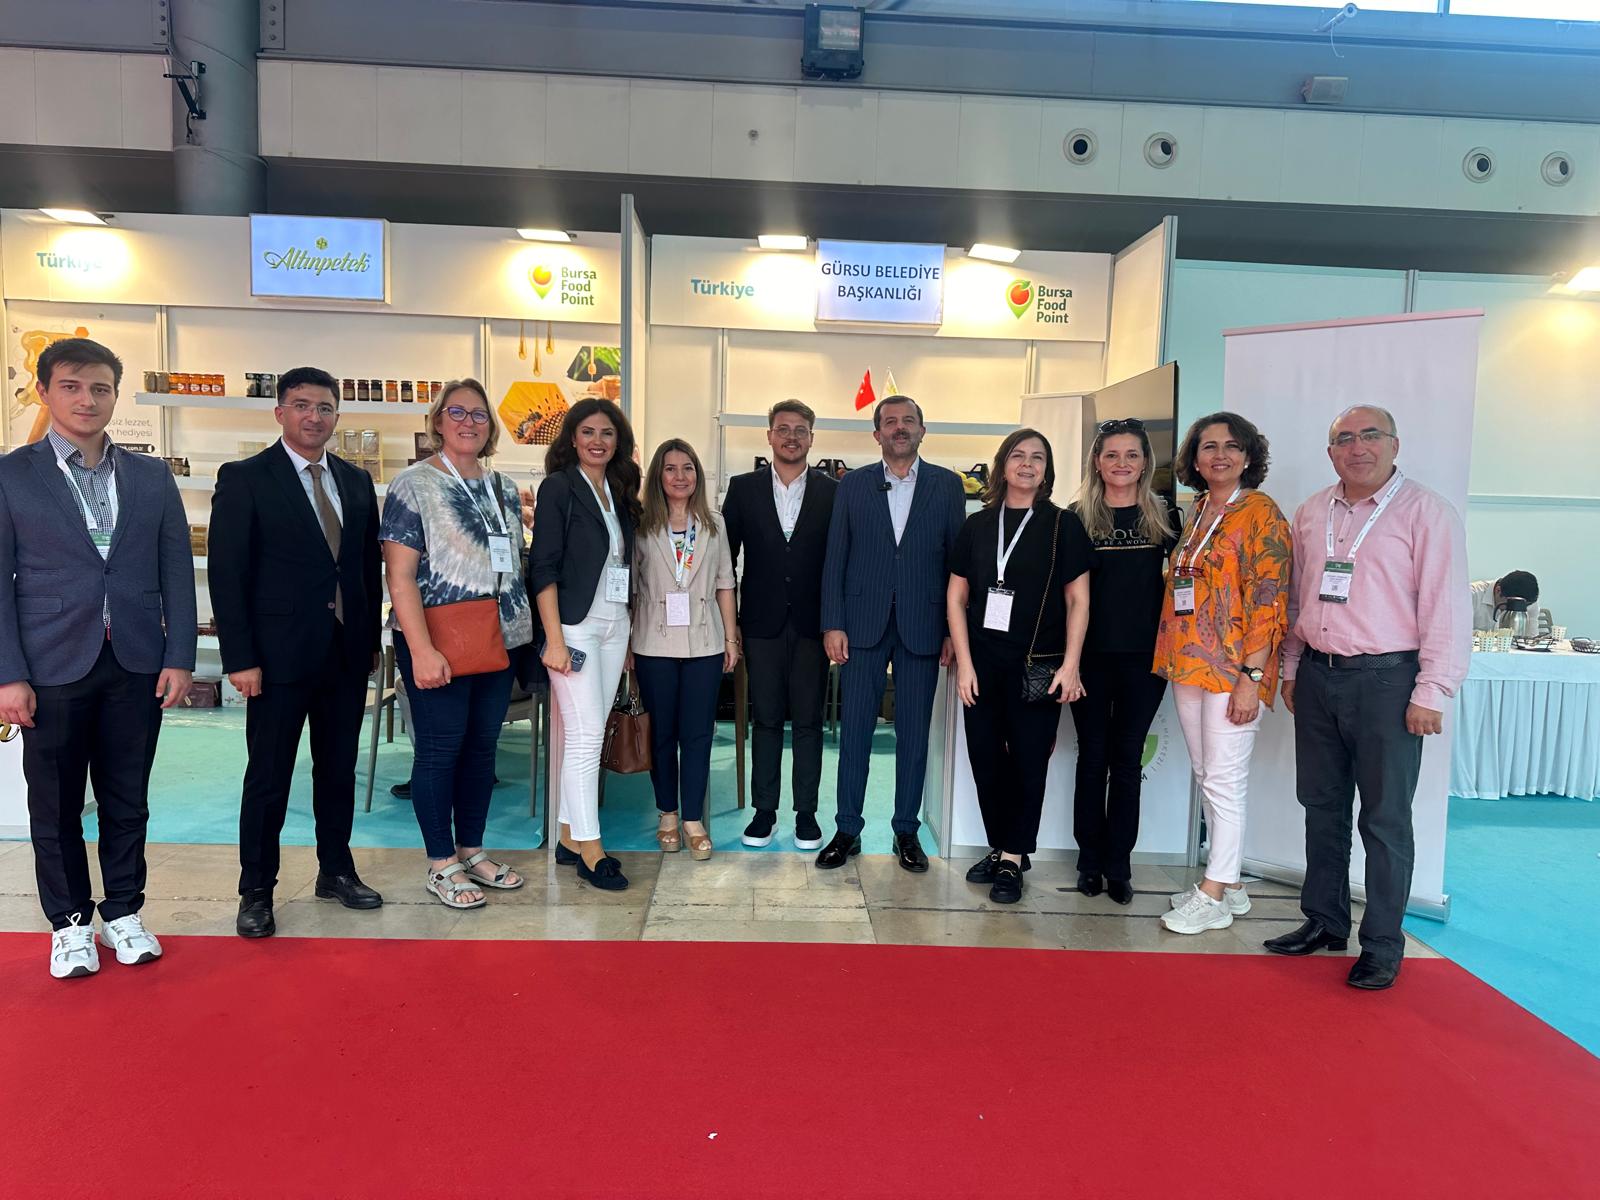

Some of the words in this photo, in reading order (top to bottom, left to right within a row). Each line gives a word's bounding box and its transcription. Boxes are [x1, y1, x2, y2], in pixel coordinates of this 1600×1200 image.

[561, 266, 597, 279] Bursa
[821, 260, 871, 277] GÜRSU
[875, 264, 940, 280] BELEDİYE
[561, 279, 591, 292] Food
[690, 278, 754, 300] Türkiye
[1038, 285, 1073, 298] Bursa
[561, 292, 595, 306] Point
[837, 285, 922, 302] BAŞKANLIĞI
[1037, 298, 1067, 311] Food
[1036, 311, 1069, 323] Point
